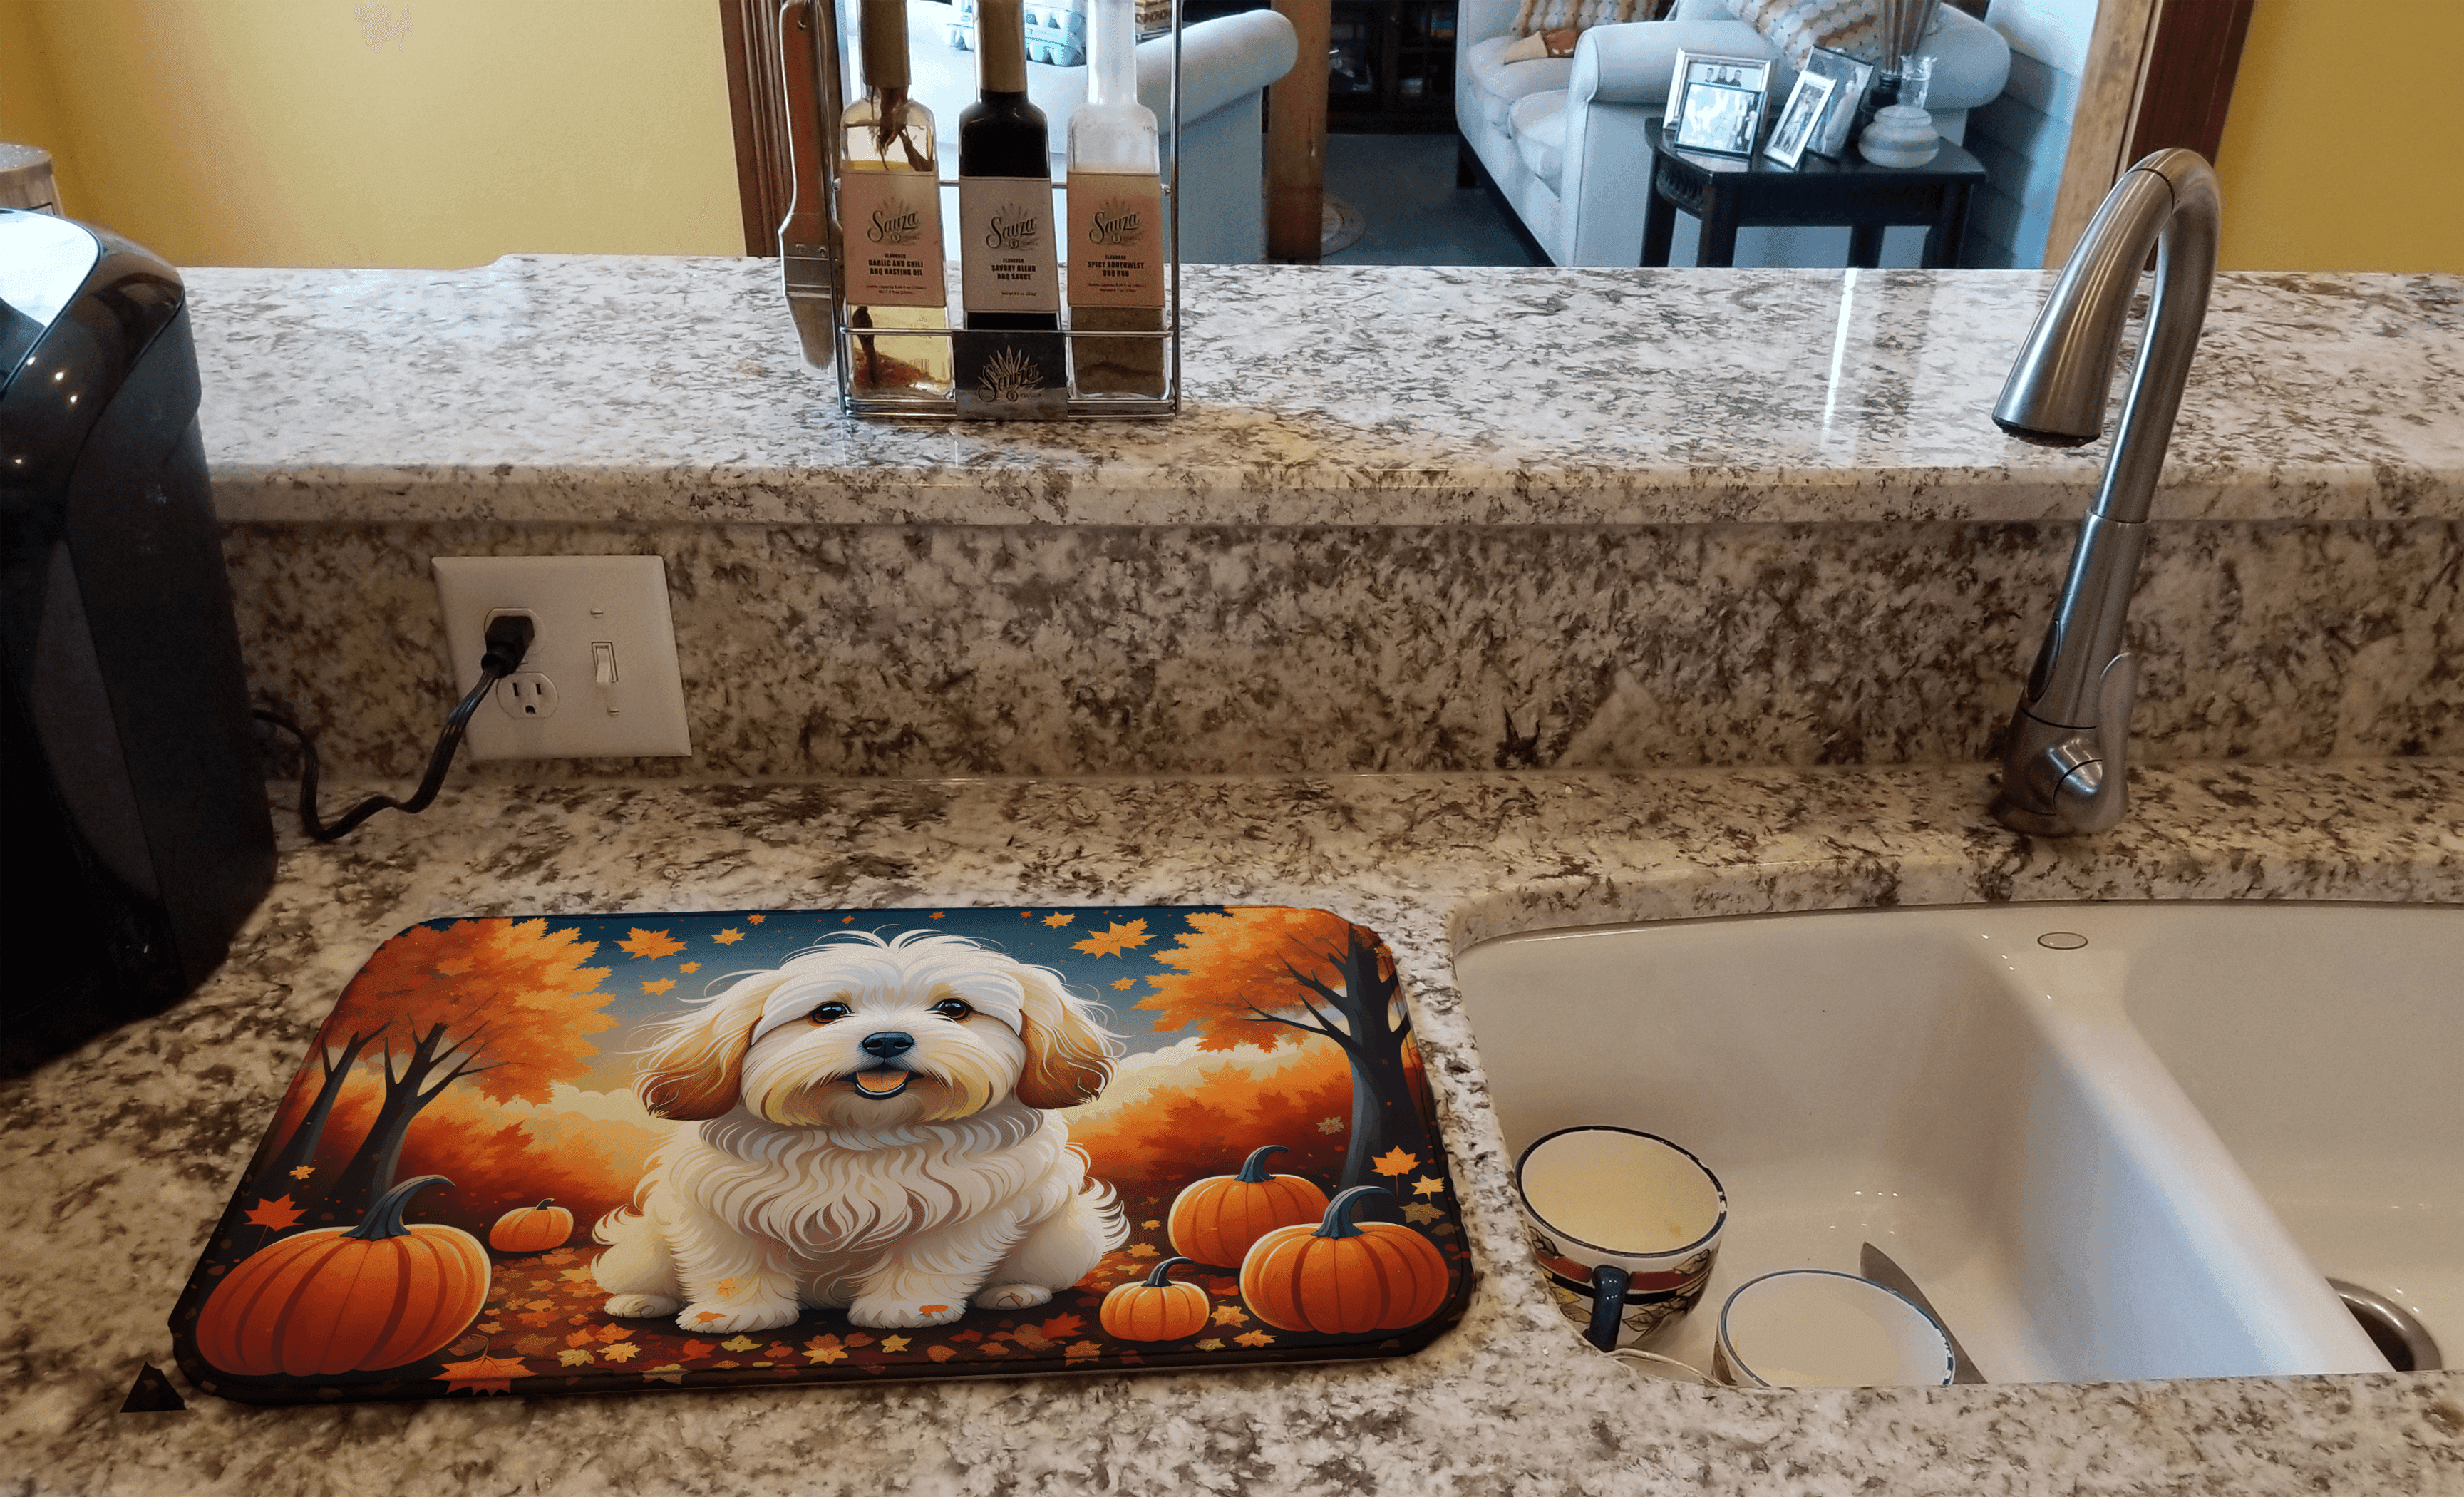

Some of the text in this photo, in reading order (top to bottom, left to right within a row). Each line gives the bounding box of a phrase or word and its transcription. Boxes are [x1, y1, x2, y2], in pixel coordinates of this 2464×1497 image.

[867, 210, 919, 243] Sauza
[986, 216, 1037, 250] Sauza
[1089, 211, 1140, 244] Sauza
[978, 364, 1043, 403] Sauza
